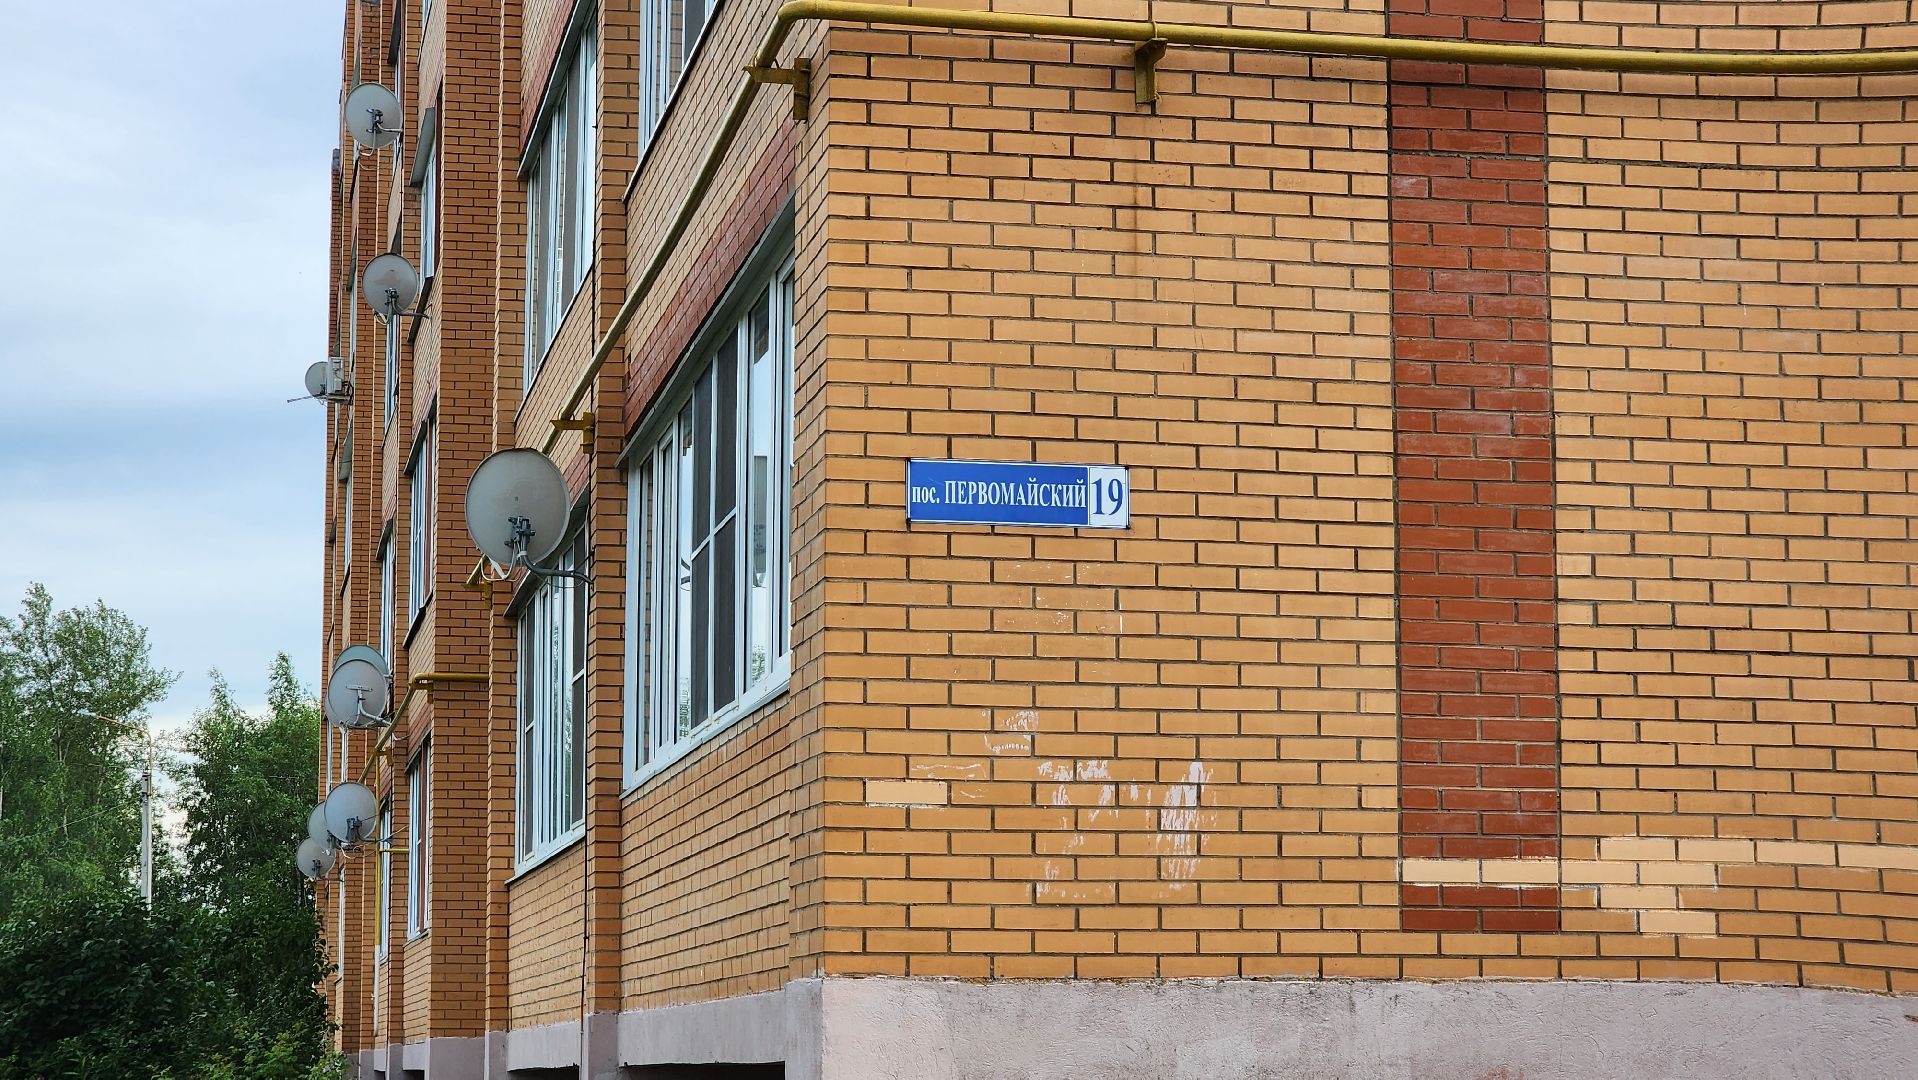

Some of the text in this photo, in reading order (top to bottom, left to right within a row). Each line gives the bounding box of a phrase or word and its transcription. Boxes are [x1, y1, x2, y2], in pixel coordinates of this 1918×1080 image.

[911, 477, 1124, 516] пос. ПЕРВОМАЙСКИЙ 19
